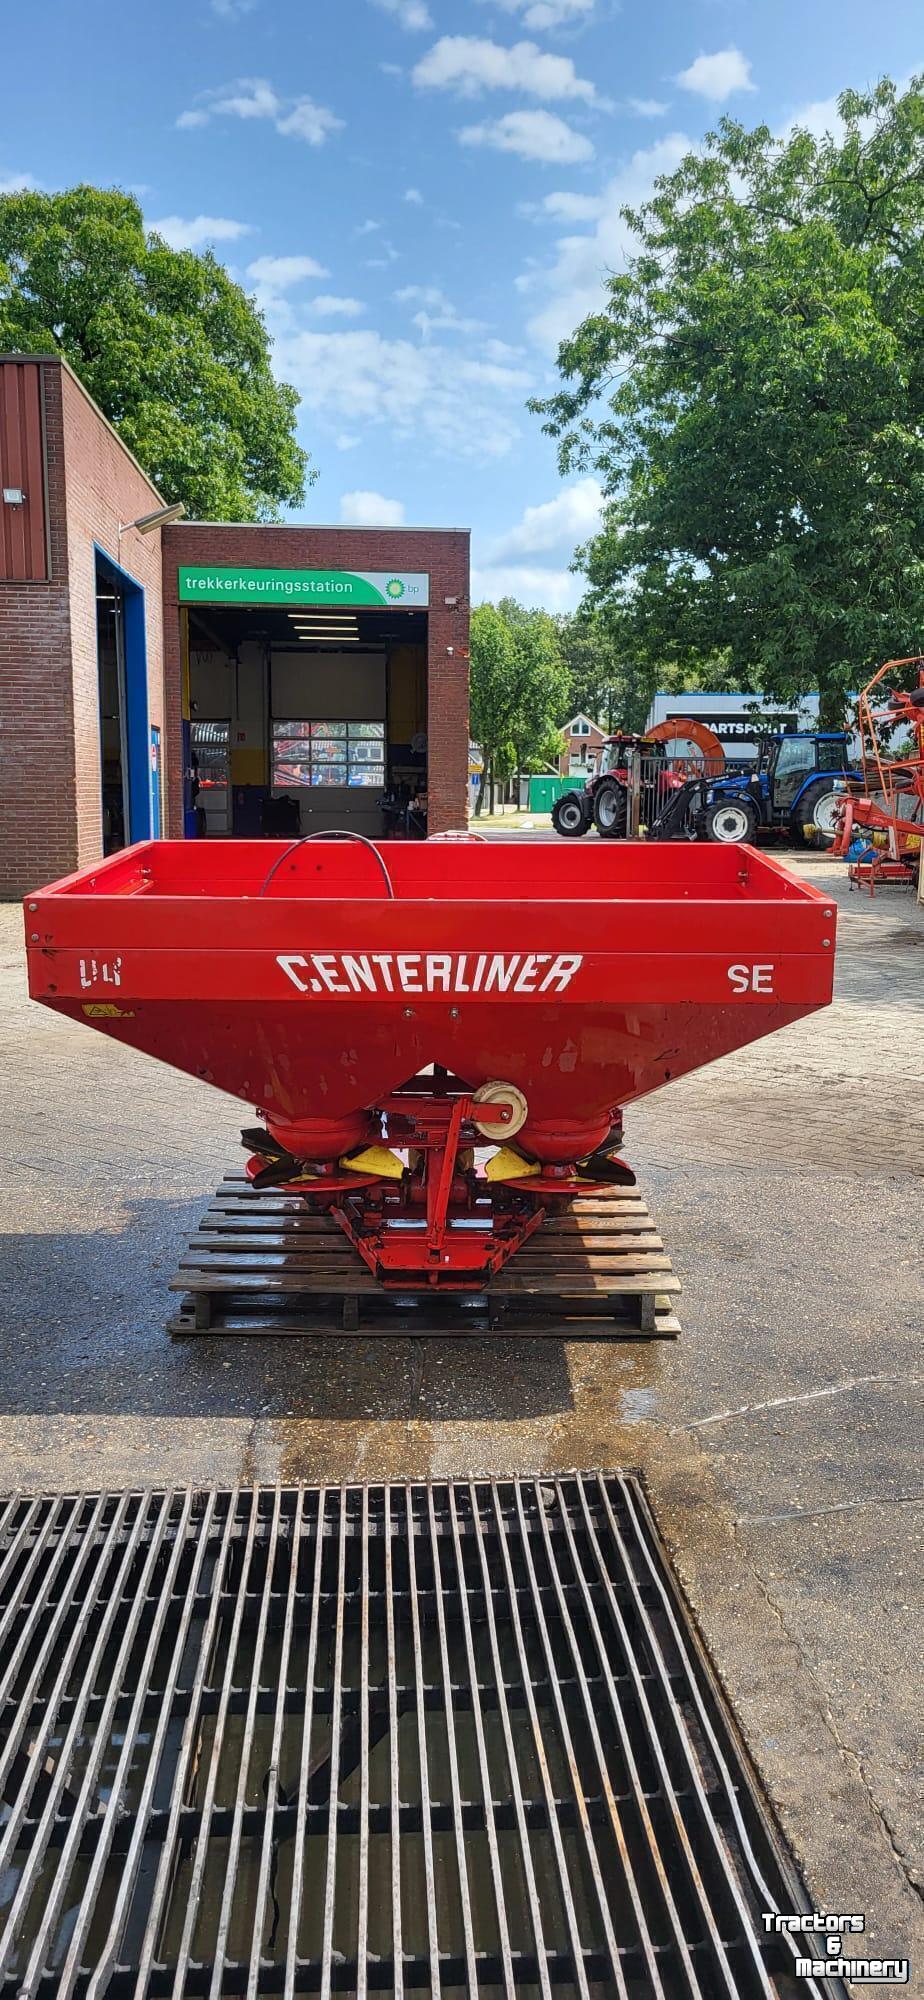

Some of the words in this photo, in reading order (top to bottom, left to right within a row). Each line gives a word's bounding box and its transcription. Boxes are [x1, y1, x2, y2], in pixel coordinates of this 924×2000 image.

[186, 576, 353, 594] trekkerkeuringsstation
[408, 584, 420, 594] bp
[275, 954, 584, 993] CENTERLINER
[727, 964, 775, 993] SE
